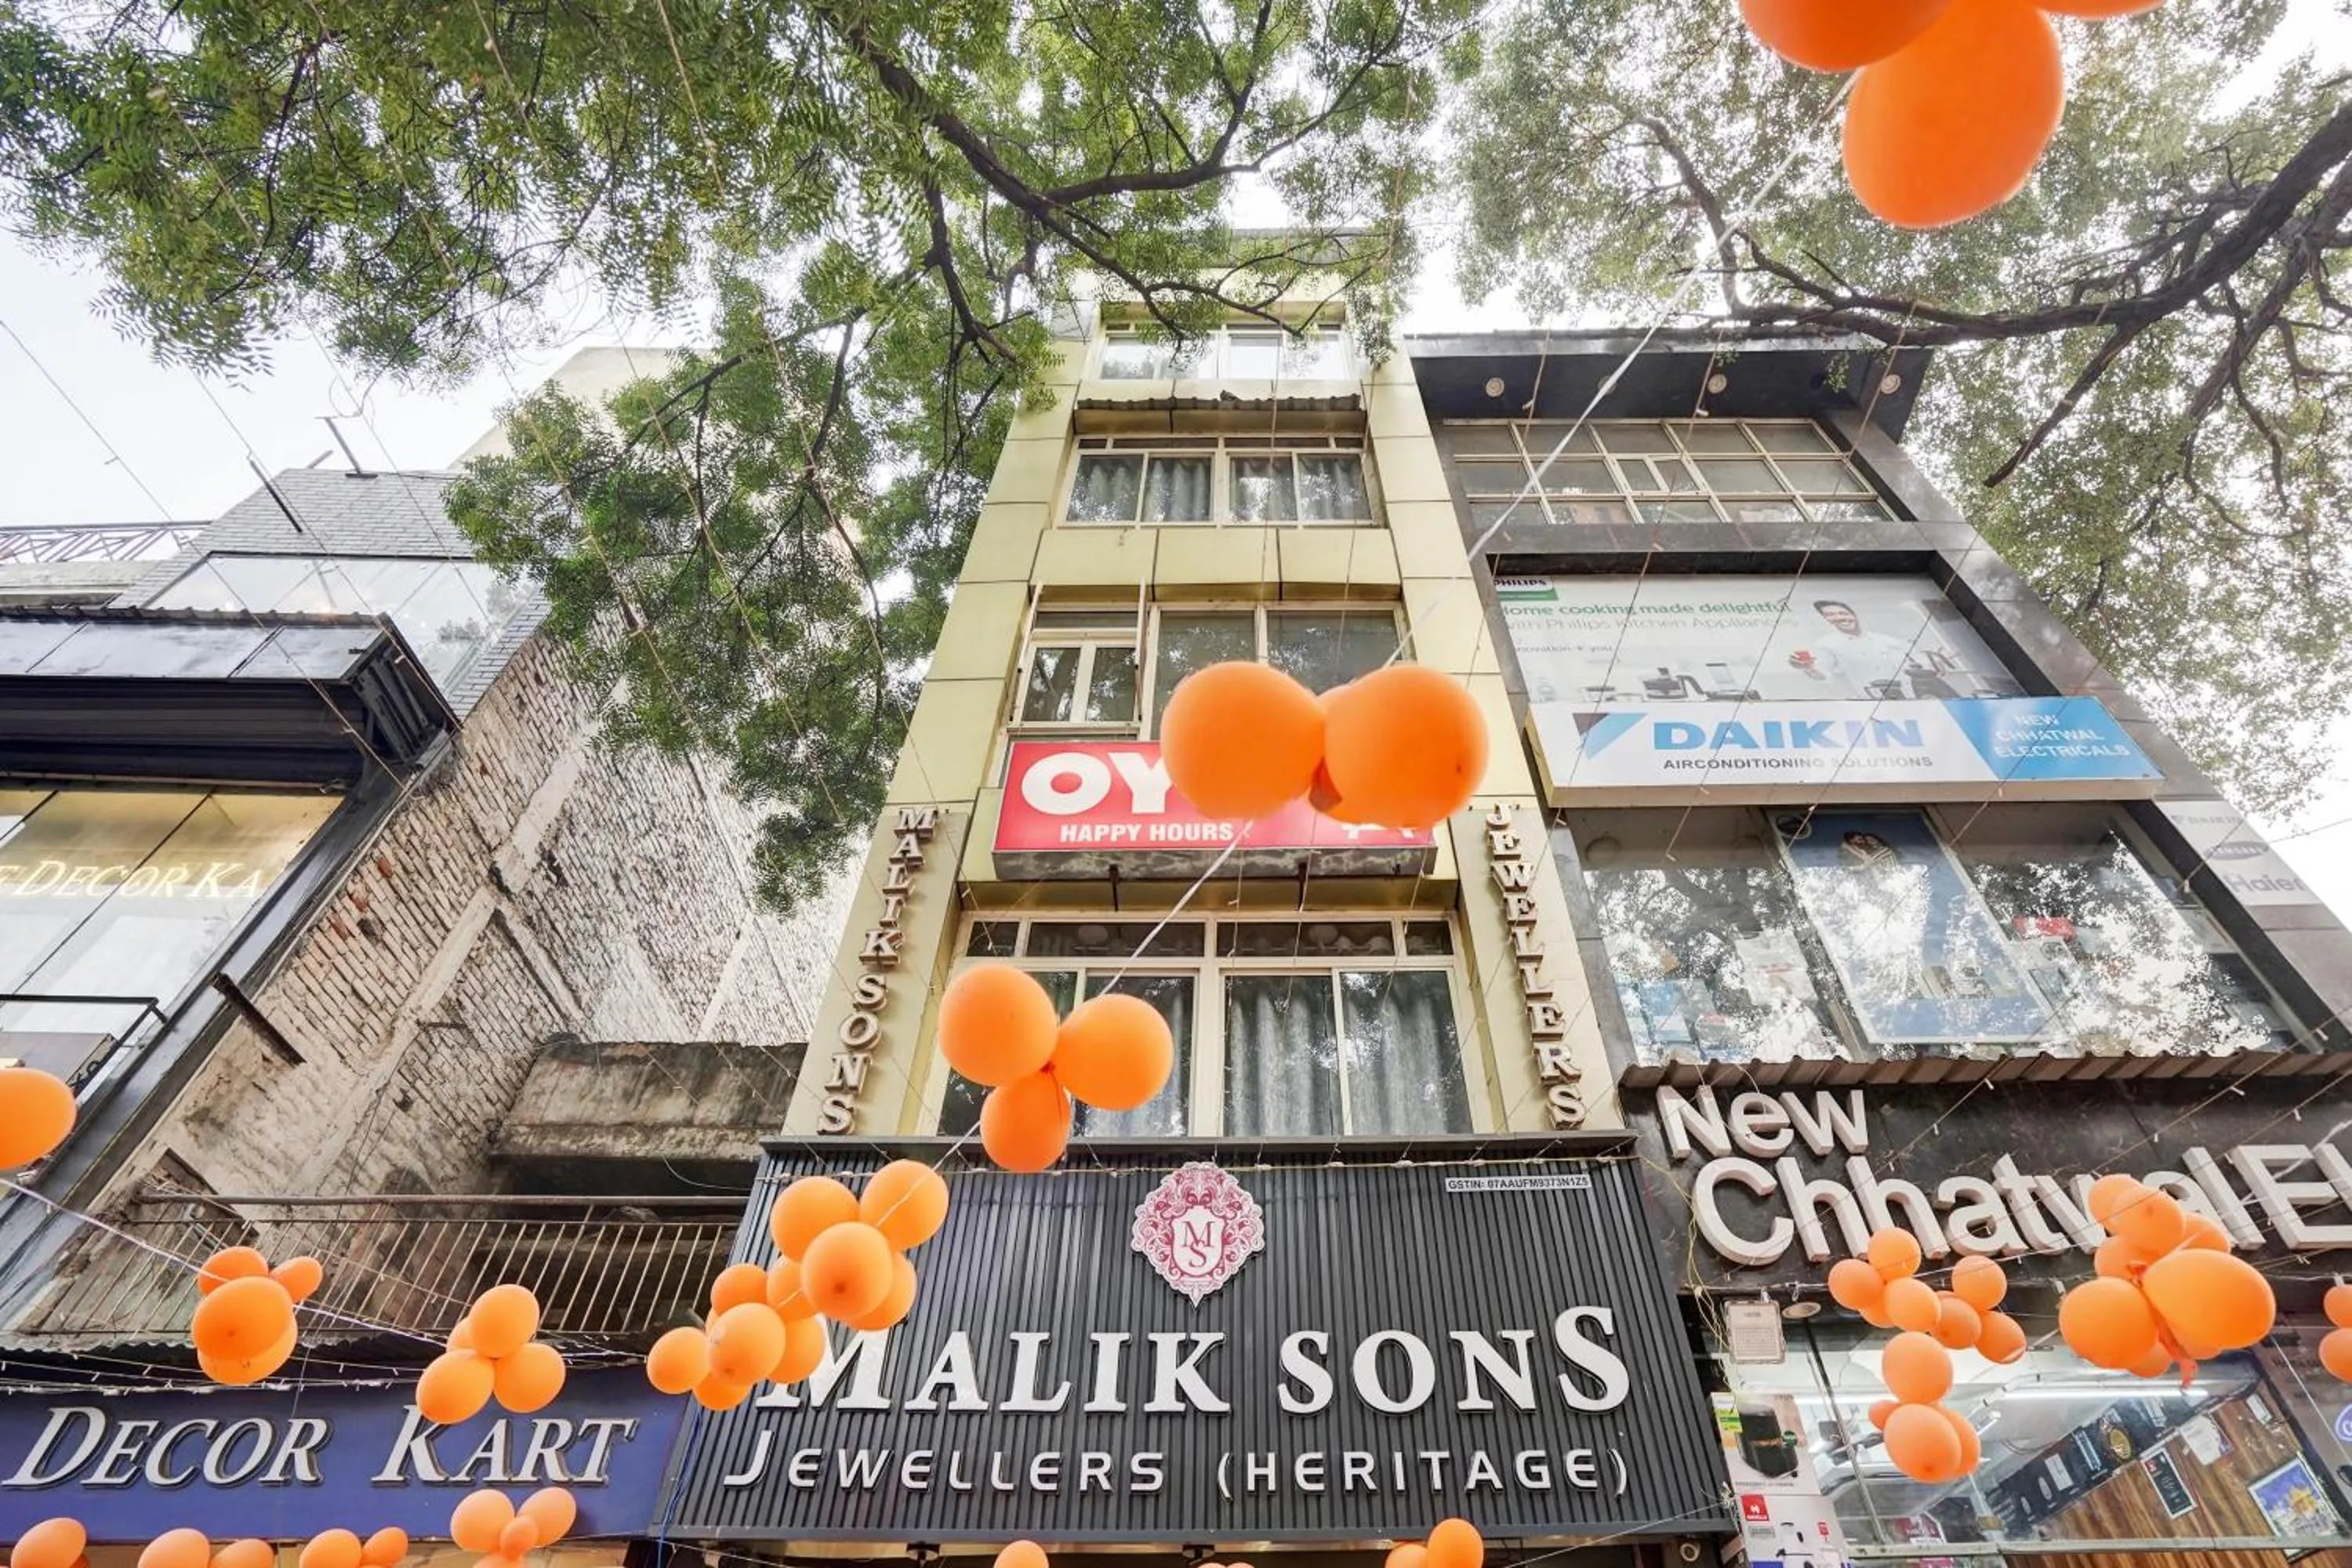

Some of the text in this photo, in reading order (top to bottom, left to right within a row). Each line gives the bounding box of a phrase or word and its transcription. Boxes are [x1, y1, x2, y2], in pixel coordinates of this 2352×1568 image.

[1559, 604, 1636, 617] cooking
[1639, 604, 1694, 615] made
[2013, 714, 2060, 725] NEW
[1652, 718, 1925, 750] DAIKIN
[1994, 729, 2107, 742] CHHATWAL
[1994, 745, 2132, 758] ELECTRICALS
[1663, 756, 1933, 770] AIRCONDITIONING SOLUTIONS
[1021, 751, 1178, 815] OY
[1059, 822, 1234, 843] HAPPY HOURS
[12, 860, 192, 898] DECOR
[2223, 873, 2308, 892] Haier
[1656, 1083, 1867, 1160] New
[1449, 1180, 1485, 1190] GSTIN:
[754, 1311, 1232, 1414] MALIK
[1277, 1305, 1631, 1416] SONS
[2, 1405, 640, 1490] DECOR KART
[723, 1428, 1629, 1501] JEWELLERS (HERITAGE)
